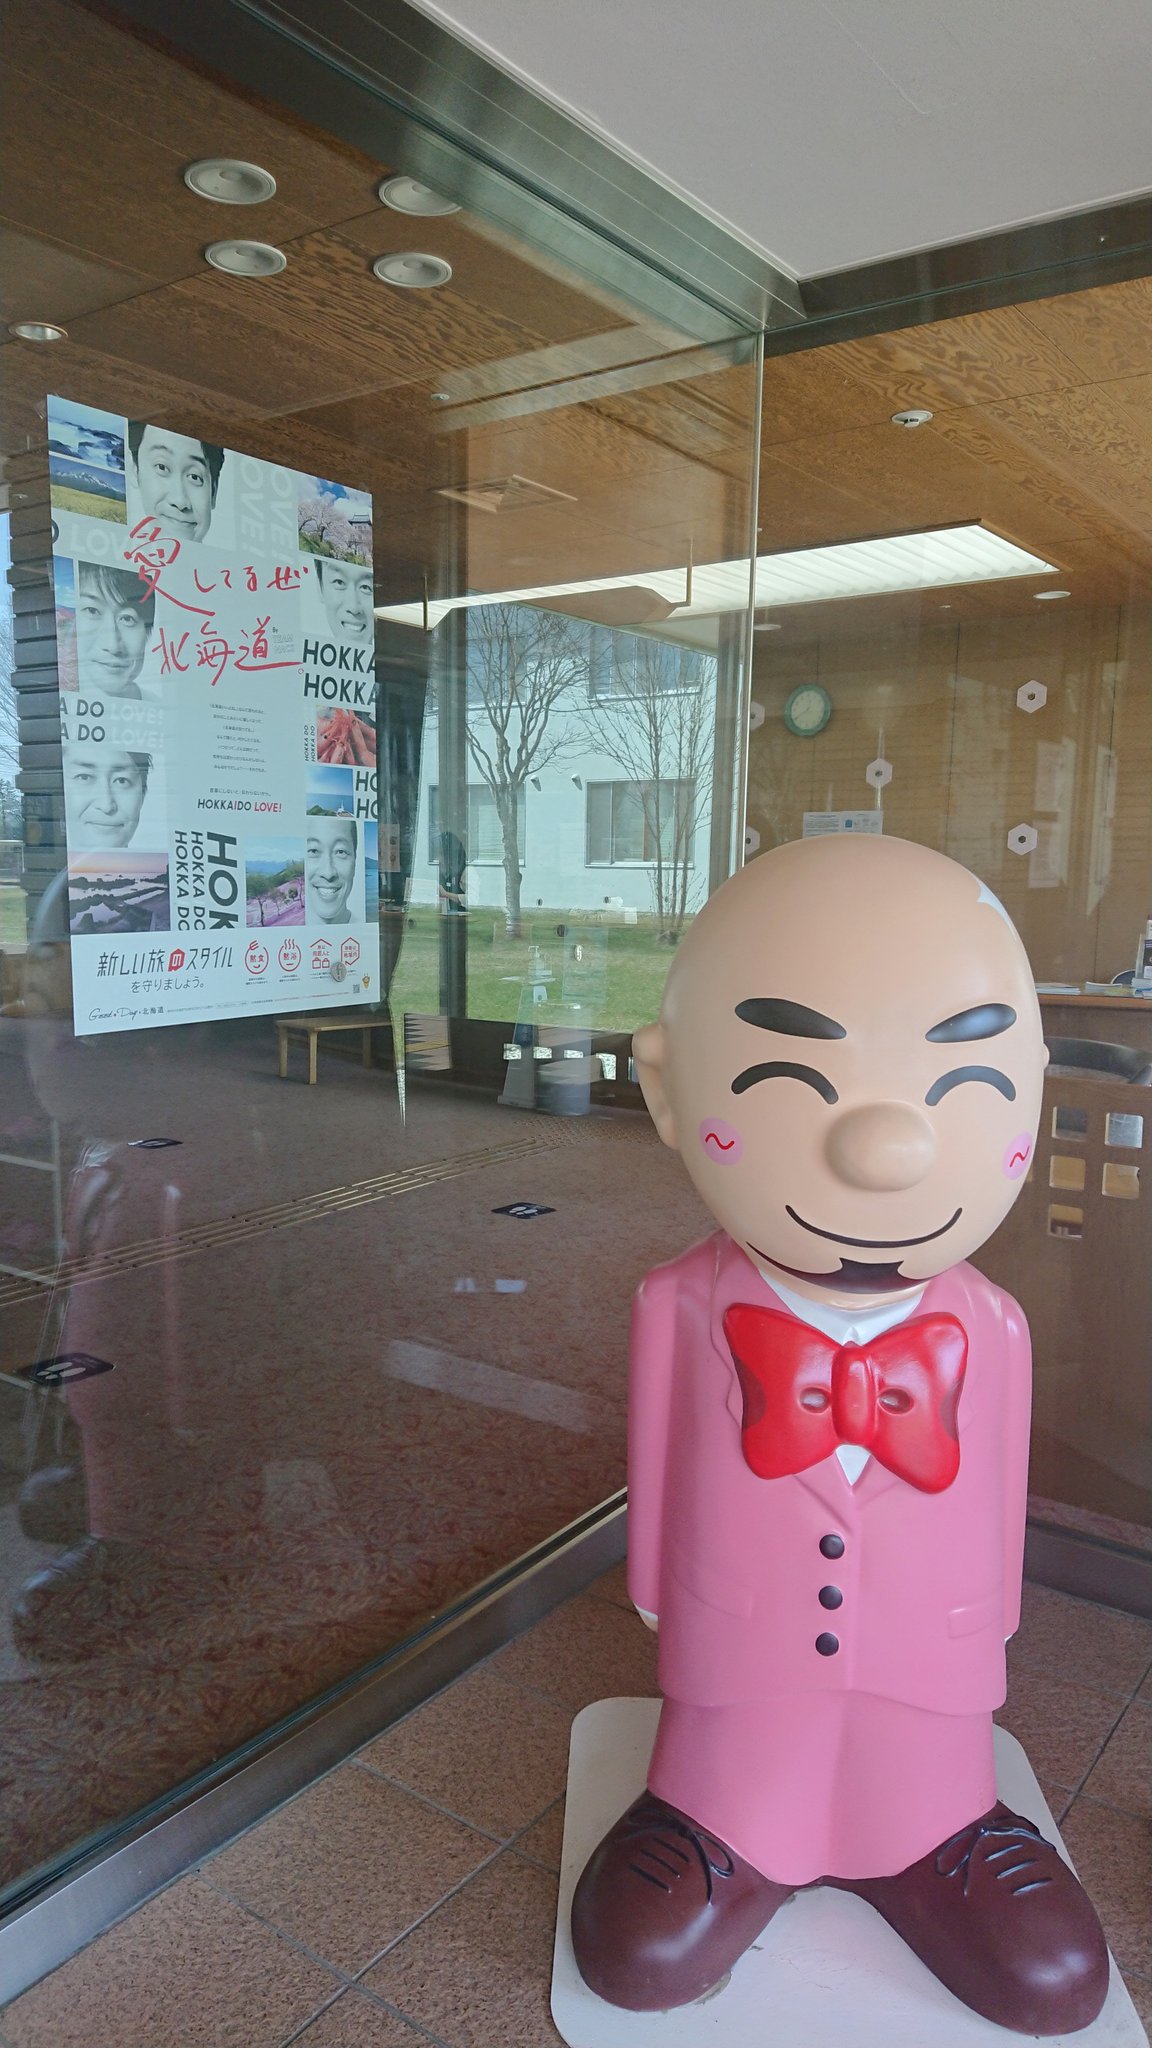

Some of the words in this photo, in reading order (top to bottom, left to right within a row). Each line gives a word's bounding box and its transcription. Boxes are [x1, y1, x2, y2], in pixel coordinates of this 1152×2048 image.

[124, 516, 309, 616] 愛してるぜ
[76, 699, 104, 718] DO
[78, 724, 105, 742] DO
[197, 798, 252, 811] HOKKAIDO
[254, 801, 282, 813] LOVE!
[174, 830, 189, 898] HOKKA
[190, 831, 205, 898] HOKKA
[97, 946, 233, 978] 新しい旅のスタイル
[131, 976, 205, 994] を守りましょう。
